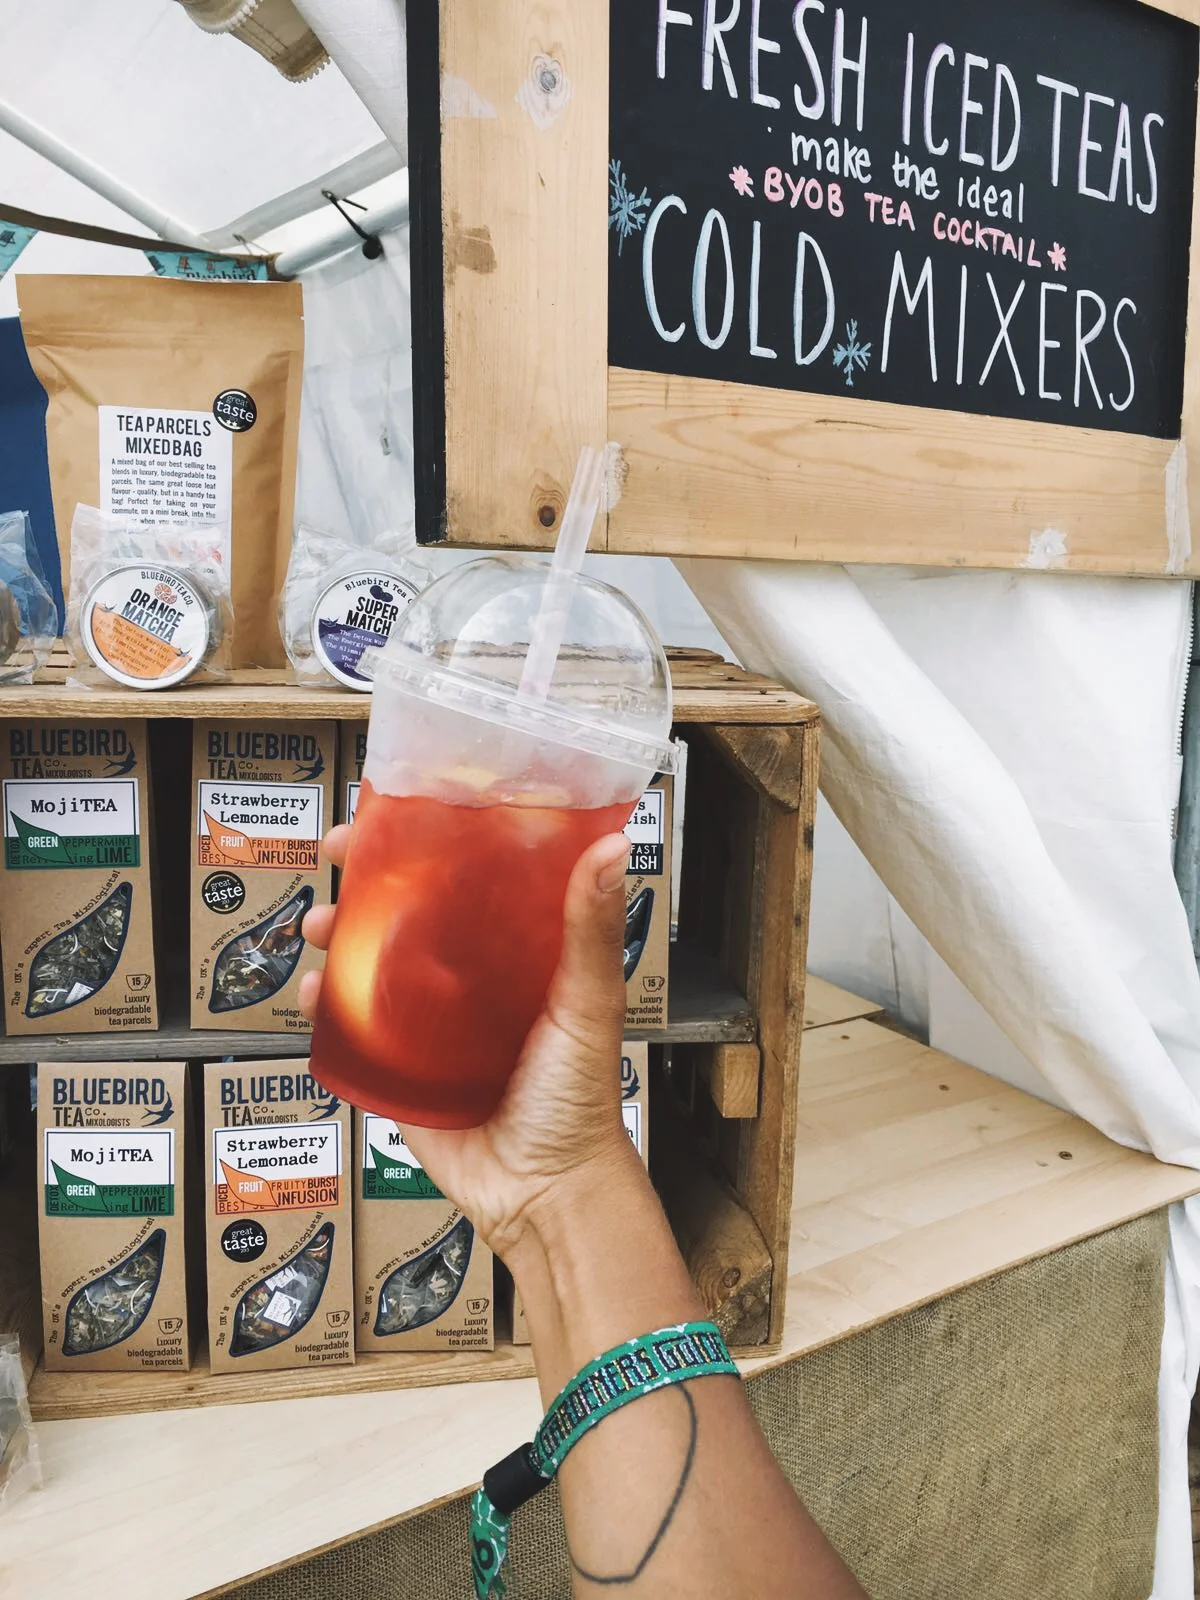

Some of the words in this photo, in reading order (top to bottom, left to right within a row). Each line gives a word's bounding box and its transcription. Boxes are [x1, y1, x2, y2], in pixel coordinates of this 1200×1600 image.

[657, 0, 868, 131] FRESH
[902, 33, 1022, 172] ICED
[1036, 75, 1165, 214] TEAS
[791, 133, 872, 183] make
[892, 151, 939, 199] the
[764, 167, 845, 217] BYOB
[864, 192, 916, 230] TEA
[933, 212, 1042, 268] COCKTAIL
[643, 195, 836, 366] COLD
[881, 250, 1137, 411] MIXERS
[226, 394, 248, 407] great
[216, 400, 254, 423] taste
[126, 437, 170, 455] MIXED
[173, 440, 202, 457] BAG
[135, 459, 147, 467] bag
[169, 460, 182, 468] best
[206, 463, 216, 471] tea
[206, 472, 216, 480] tea
[141, 571, 176, 587] BLUEBIRD
[344, 577, 390, 592] Bluebird
[392, 583, 407, 598] Tea
[130, 588, 185, 628] ORANGE
[356, 596, 399, 622] SUPER
[120, 601, 176, 642] MATCHA
[10, 729, 127, 757] BLUEBIRD
[207, 730, 317, 762] BLUEBIRD
[10, 758, 44, 779] TEA
[207, 759, 239, 780] TEA
[239, 772, 282, 781] MIXOLOGISTS
[30, 797, 118, 816] MojiTEA
[211, 792, 310, 811] Strawberry
[220, 811, 299, 826] Lemonade
[28, 836, 59, 848] GREEN
[65, 837, 132, 848] PEPPERMINT
[201, 834, 211, 854] ICED
[220, 836, 245, 848] FRUIT
[251, 839, 287, 849] FRUITY
[287, 840, 317, 851] BURST
[96, 847, 132, 864] LIME
[257, 850, 317, 865] INFUSION
[210, 878, 231, 892] great
[204, 884, 243, 904] taste
[23, 930, 52, 956] expert
[53, 919, 72, 932] Tea
[210, 927, 238, 952] expert
[238, 918, 256, 930] Tea
[132, 977, 141, 986] 15
[647, 979, 656, 987] 15
[124, 994, 150, 1004] Luxury
[640, 995, 663, 1004] Luxury
[94, 1005, 152, 1017] biodegradable
[109, 1017, 121, 1026] tea
[122, 1016, 152, 1028] parcels
[285, 1019, 298, 1028] tea
[636, 1016, 662, 1025] parcels
[53, 1078, 165, 1105] BLUEBIRD
[53, 1106, 85, 1127] TEA
[85, 1118, 131, 1127] MIXOLOGISTS
[221, 1105, 253, 1127] TEA
[254, 1114, 298, 1125] MIXOLOGISTS
[227, 1135, 328, 1152] Strawberry
[70, 1147, 154, 1165] MojiTEA
[237, 1152, 318, 1169] Lemonade
[383, 1167, 412, 1179] GREEN
[66, 1184, 96, 1197] GREEN
[102, 1186, 166, 1196] PEPPERMINT
[218, 1183, 228, 1202] ICED
[238, 1180, 264, 1193] FRUIT
[271, 1180, 307, 1191] FRUITY
[307, 1176, 337, 1189] BURST
[131, 1196, 166, 1213] LIME
[278, 1188, 337, 1206] INFUSION
[231, 1227, 253, 1239] great
[223, 1234, 265, 1251] taste
[375, 1256, 402, 1280] expert
[403, 1247, 420, 1258] Tea
[61, 1276, 88, 1298] expert
[88, 1265, 106, 1276] Tea
[230, 1274, 258, 1298] expert
[259, 1263, 277, 1274] Tea
[472, 1302, 480, 1310] 15
[163, 1321, 173, 1329] 15
[331, 1314, 340, 1322] 15
[464, 1317, 488, 1326] Luxury
[324, 1330, 349, 1340] Luxury
[435, 1328, 488, 1338] biodegradable
[156, 1337, 182, 1347] Luxury
[294, 1340, 349, 1353] biodegradable
[448, 1338, 460, 1346] tea
[461, 1337, 488, 1347] parcels
[127, 1347, 183, 1358] biodegradable
[308, 1353, 321, 1361] tea
[321, 1351, 349, 1362] parcels
[141, 1358, 154, 1366] tea
[155, 1357, 183, 1367] parcels
